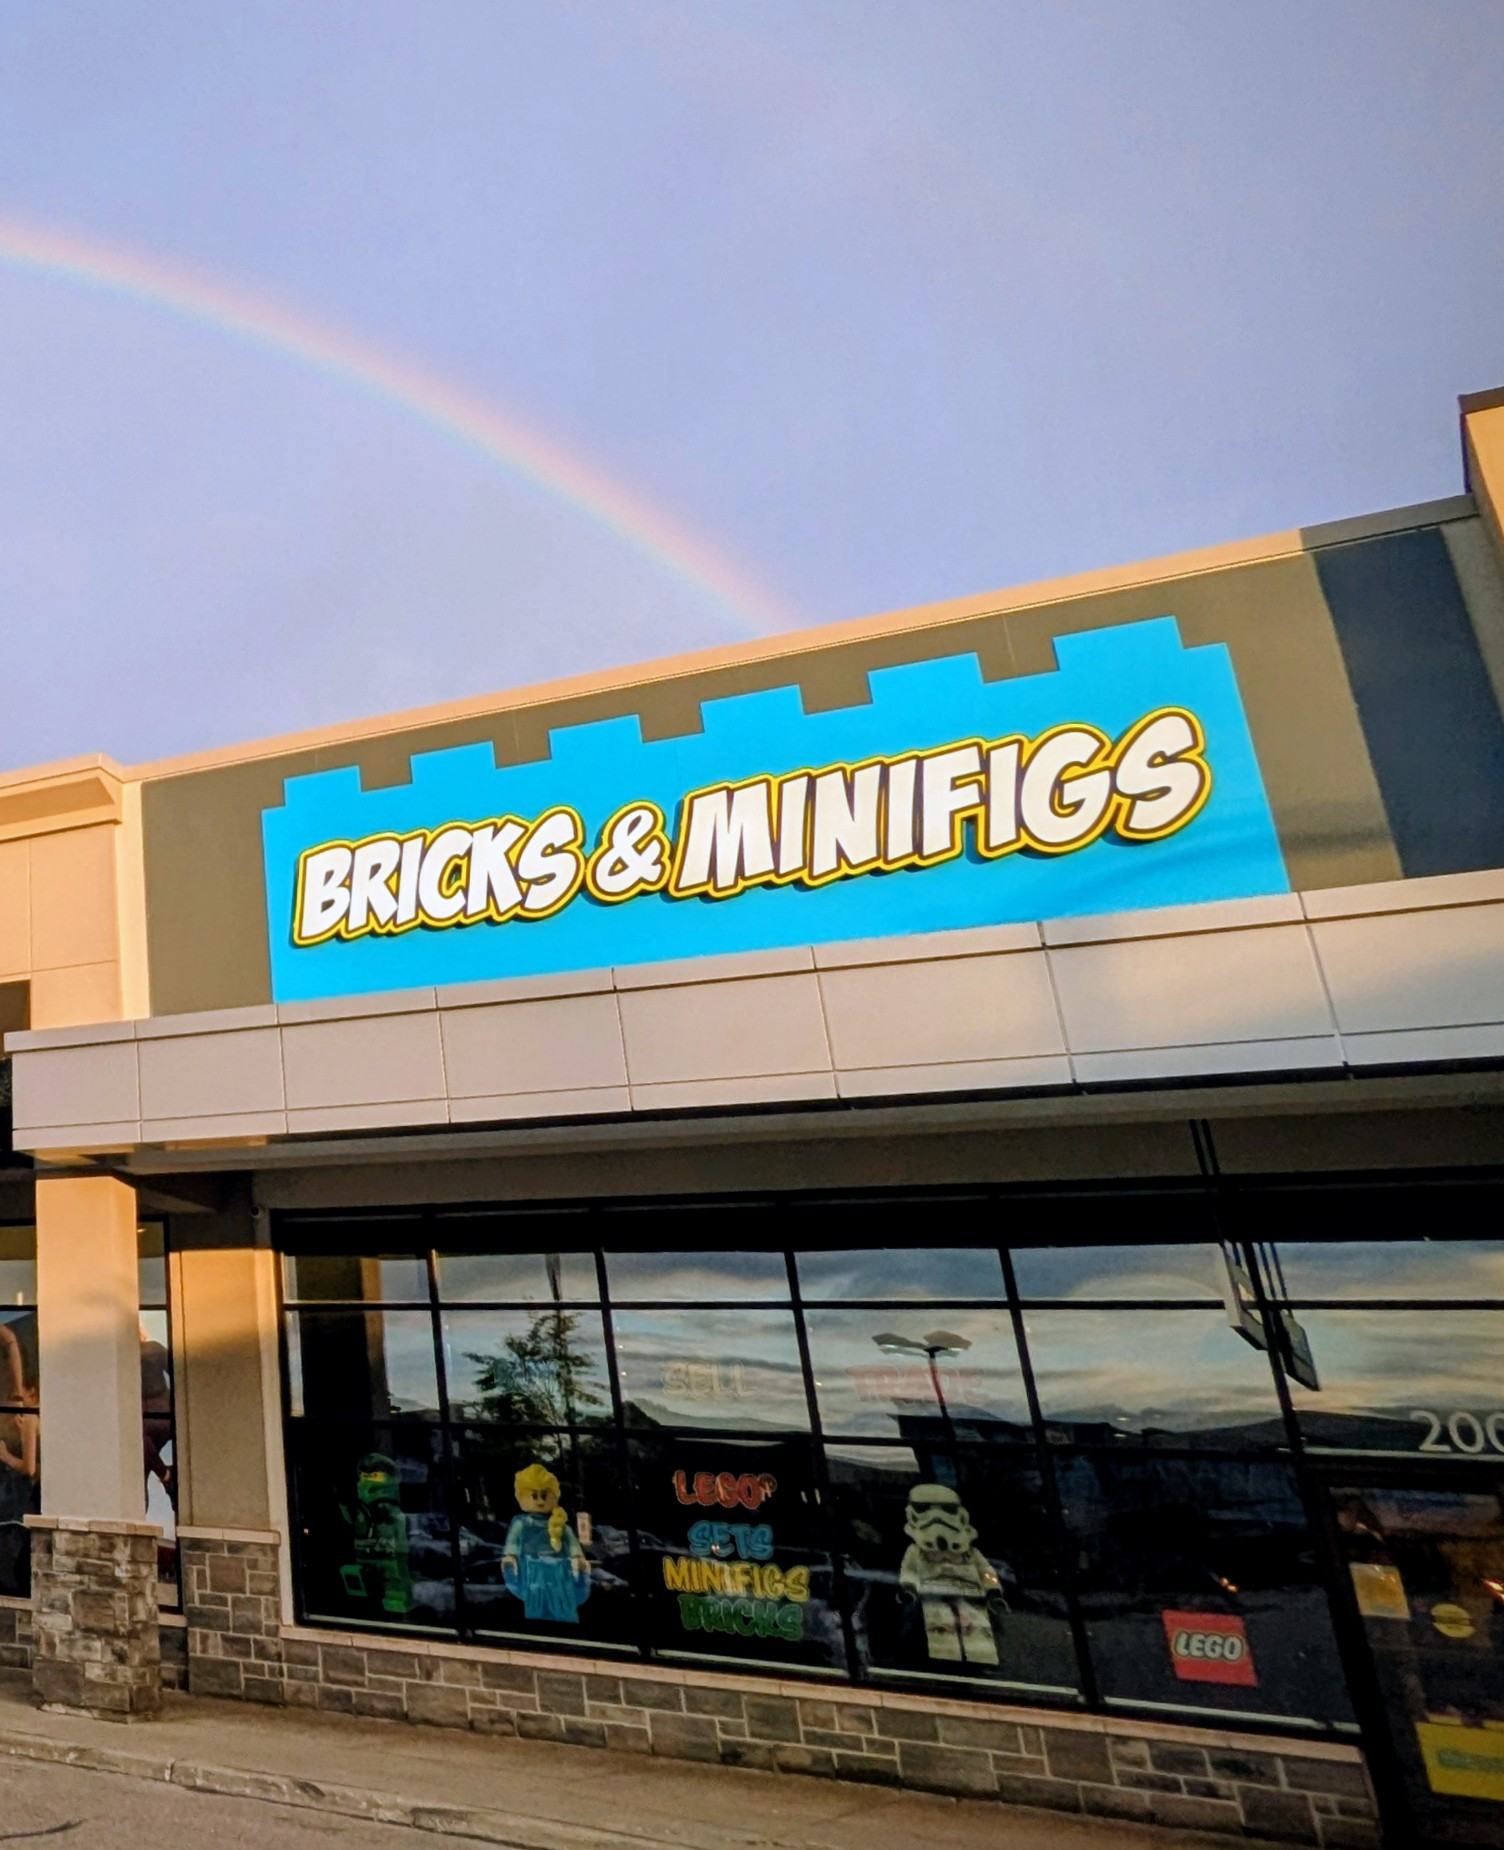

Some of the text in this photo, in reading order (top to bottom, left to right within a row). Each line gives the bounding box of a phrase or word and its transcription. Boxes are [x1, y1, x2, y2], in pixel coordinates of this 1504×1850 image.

[295, 706, 1211, 943] BRICKS & MINIFIGS
[688, 1520, 773, 1559] SETS
[663, 1556, 810, 1602] MINIFIGS
[677, 1594, 804, 1640] BRICKS
[1175, 1631, 1243, 1661] LEGO
